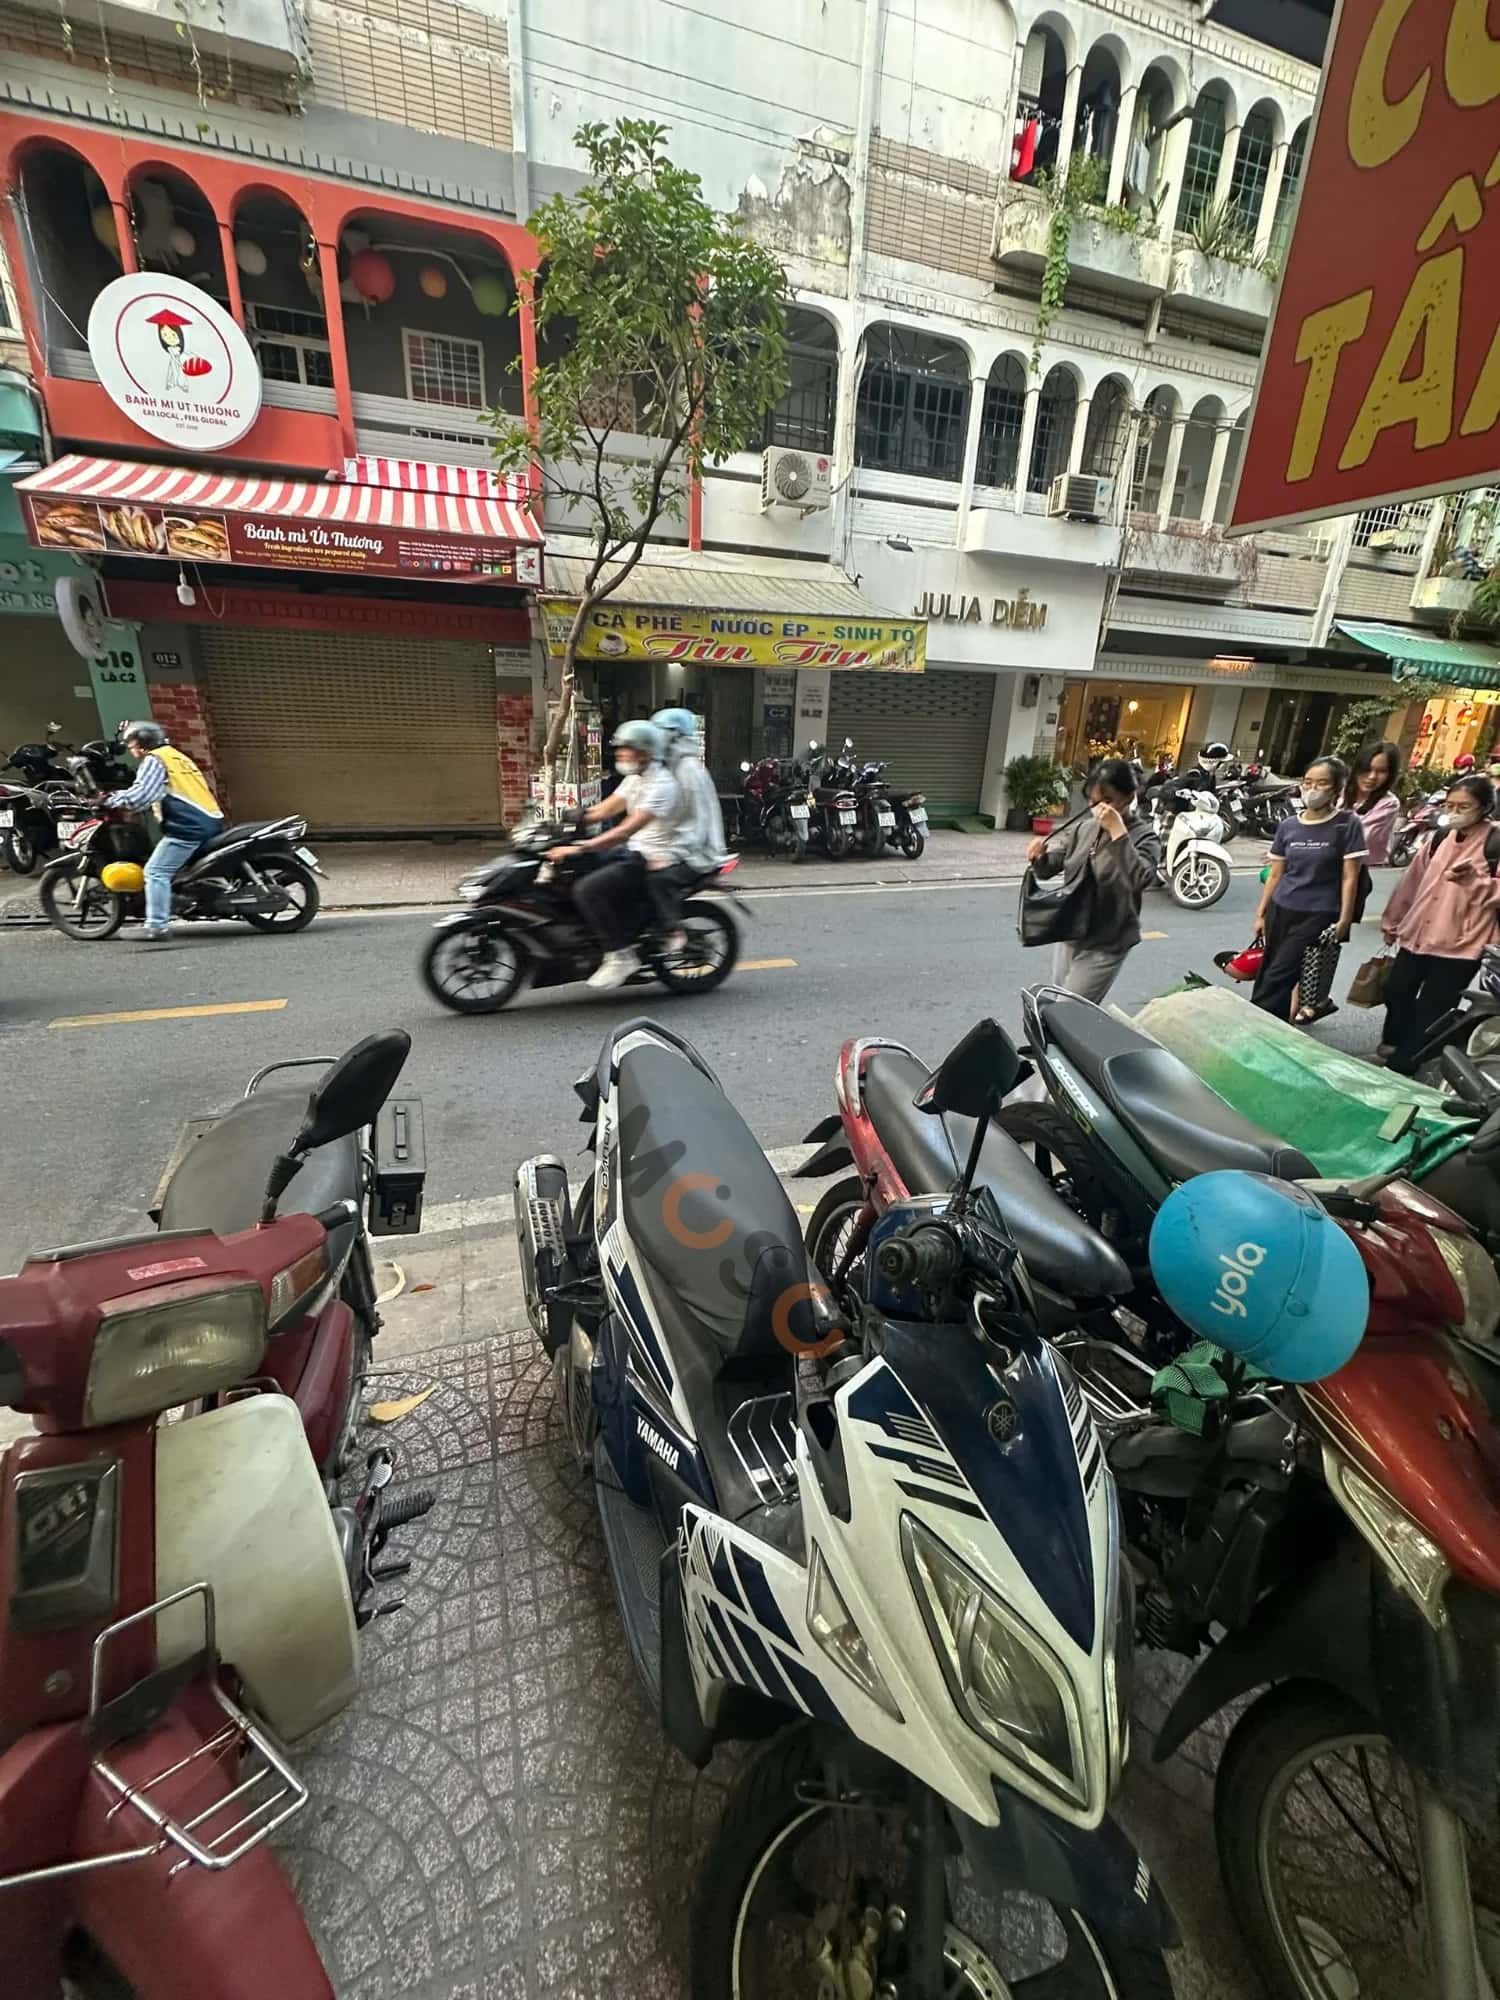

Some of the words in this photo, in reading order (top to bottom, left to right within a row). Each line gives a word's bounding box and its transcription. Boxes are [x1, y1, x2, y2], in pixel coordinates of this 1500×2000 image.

[125, 394, 157, 408] BANH
[161, 399, 174, 409] MI
[177, 401, 192, 412] UT
[194, 404, 241, 418] THUONG
[244, 522, 286, 541] Bánh
[288, 527, 308, 543] mì
[310, 525, 329, 545] Út
[331, 531, 384, 554] Thương
[912, 591, 982, 623] JULIA
[833, 625, 882, 641] SINH
[1209, 1241, 1268, 1319] yola
[636, 1415, 680, 1472] YAMAHA
